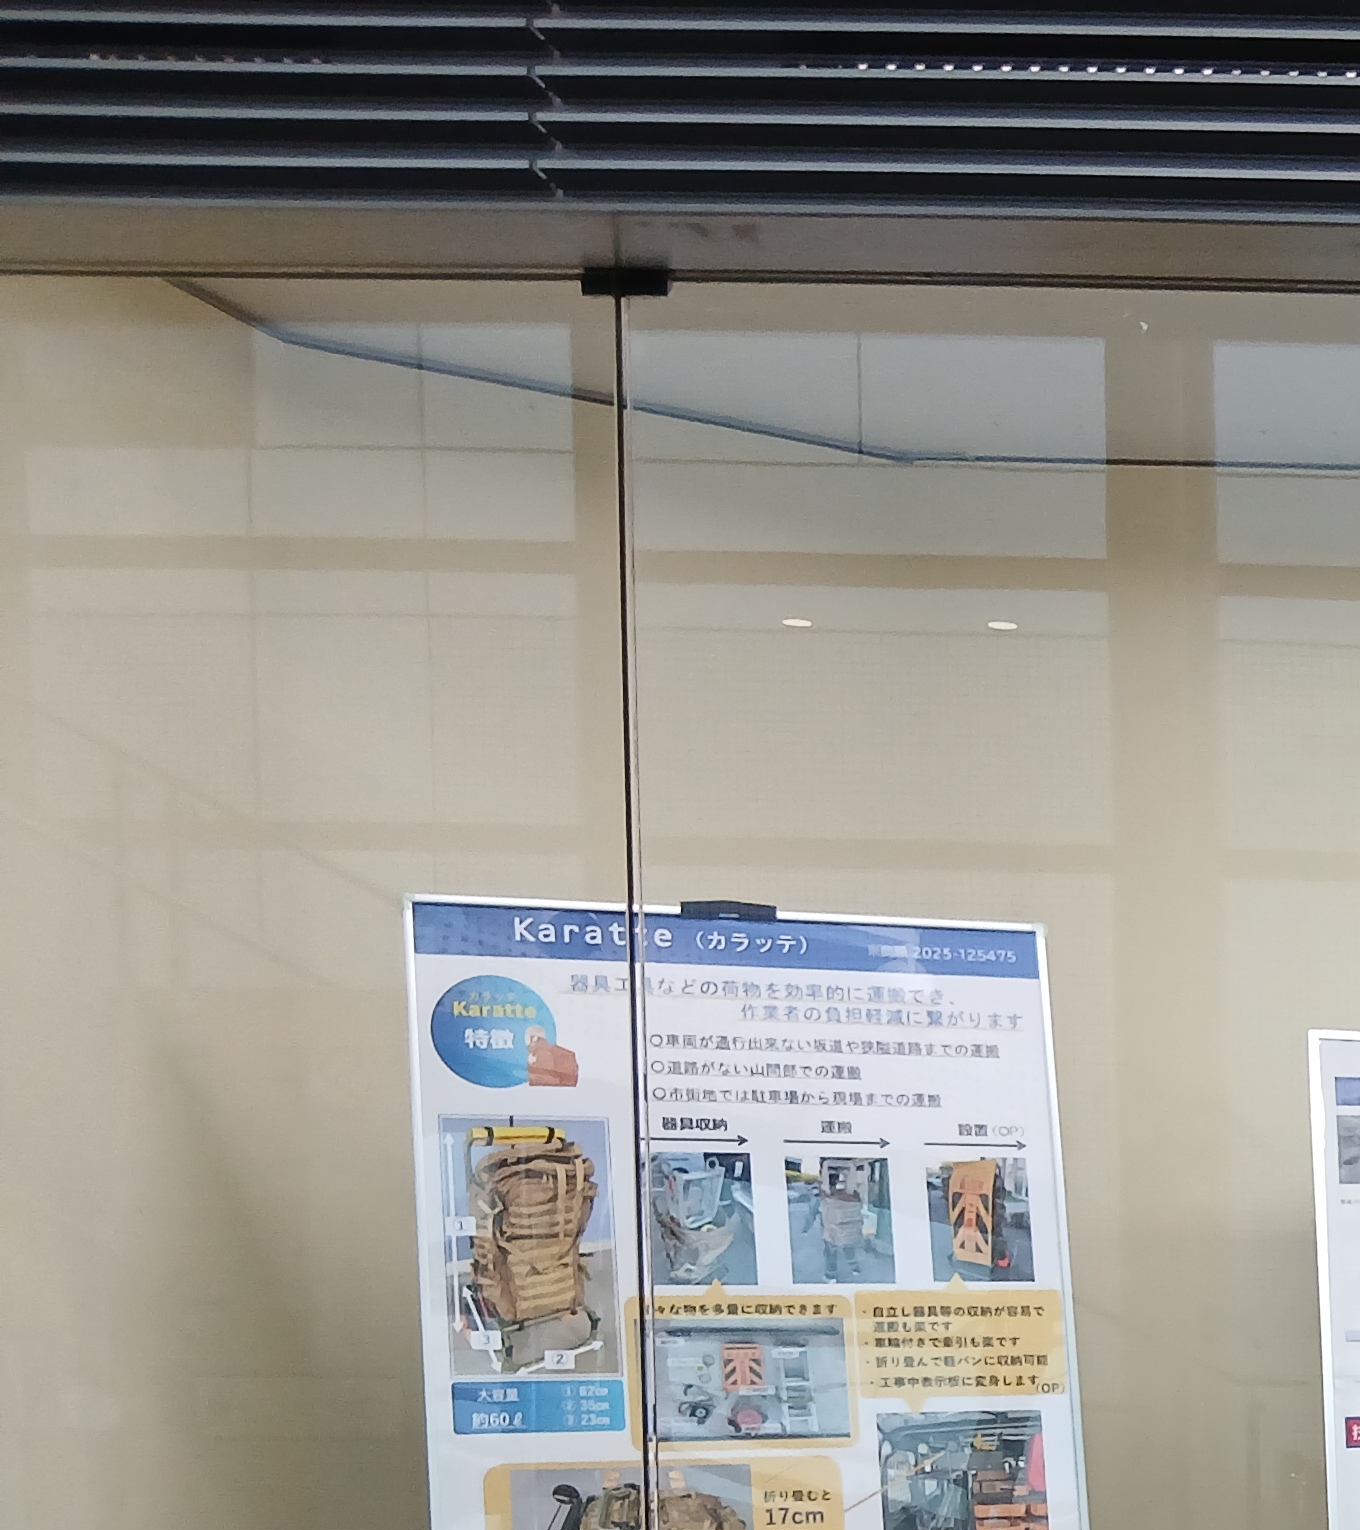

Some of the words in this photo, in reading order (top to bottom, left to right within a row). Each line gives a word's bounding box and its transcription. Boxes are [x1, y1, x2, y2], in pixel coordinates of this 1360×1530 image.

[912, 946, 1018, 964] 2025-125475
[452, 1001, 538, 1020] Karatte
[740, 1003, 1023, 1032] 作業者の負担軽減に繋がります
[464, 1027, 515, 1051] 特徴
[661, 1116, 729, 1133] 器具収納
[765, 1507, 825, 1526] 17cm
